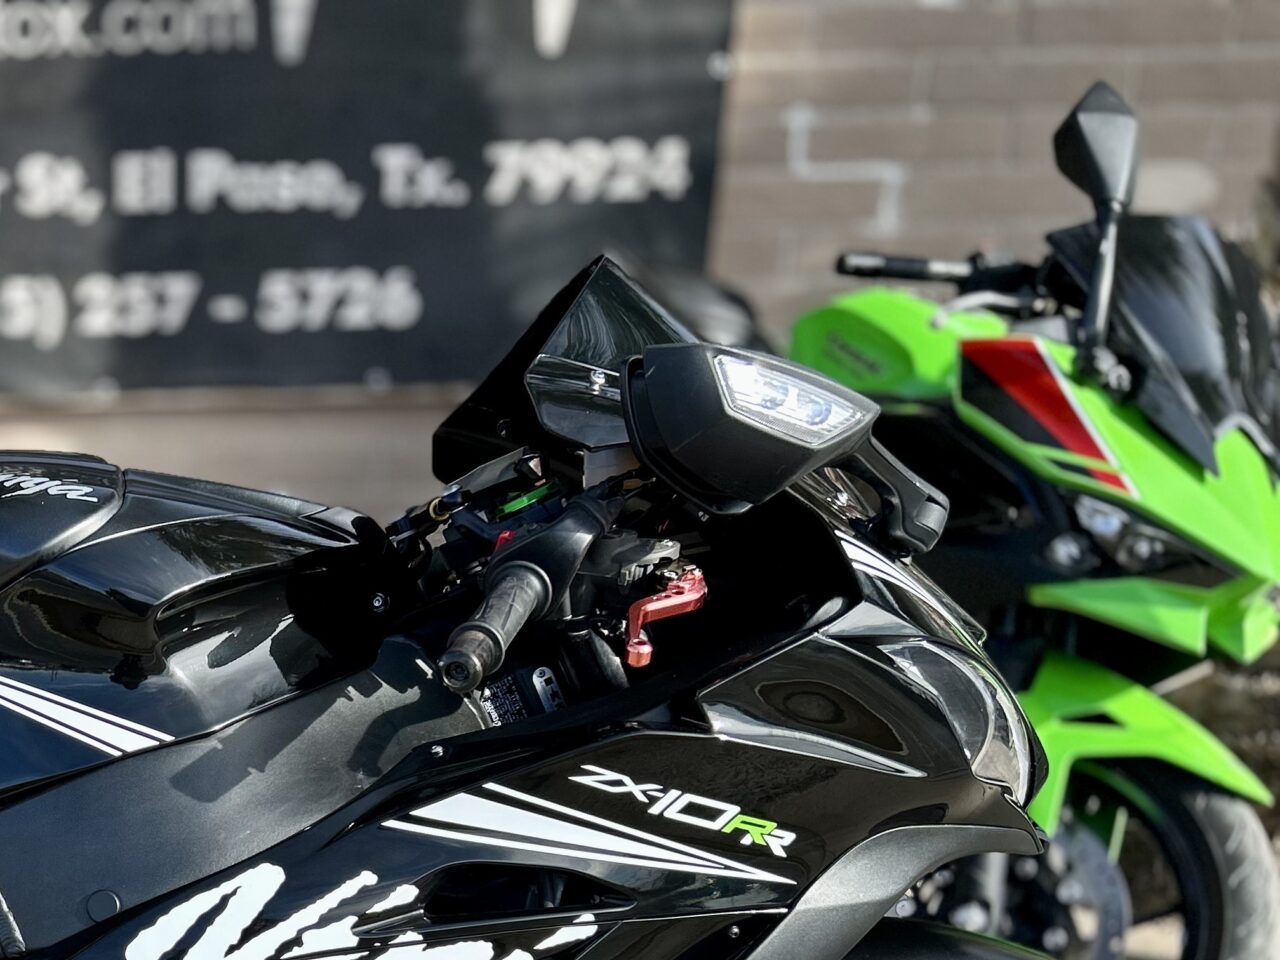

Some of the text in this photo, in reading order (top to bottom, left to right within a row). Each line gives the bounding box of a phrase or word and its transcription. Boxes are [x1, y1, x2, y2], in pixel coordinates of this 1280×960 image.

[16, 151, 102, 225] St,
[112, 147, 177, 215] El
[185, 147, 363, 219] Paso,
[372, 143, 470, 208] Tx.
[484, 135, 691, 203] 79924
[73, 270, 201, 337] 257
[255, 265, 421, 333] 5726
[568, 764, 796, 857] ZX-10RR
